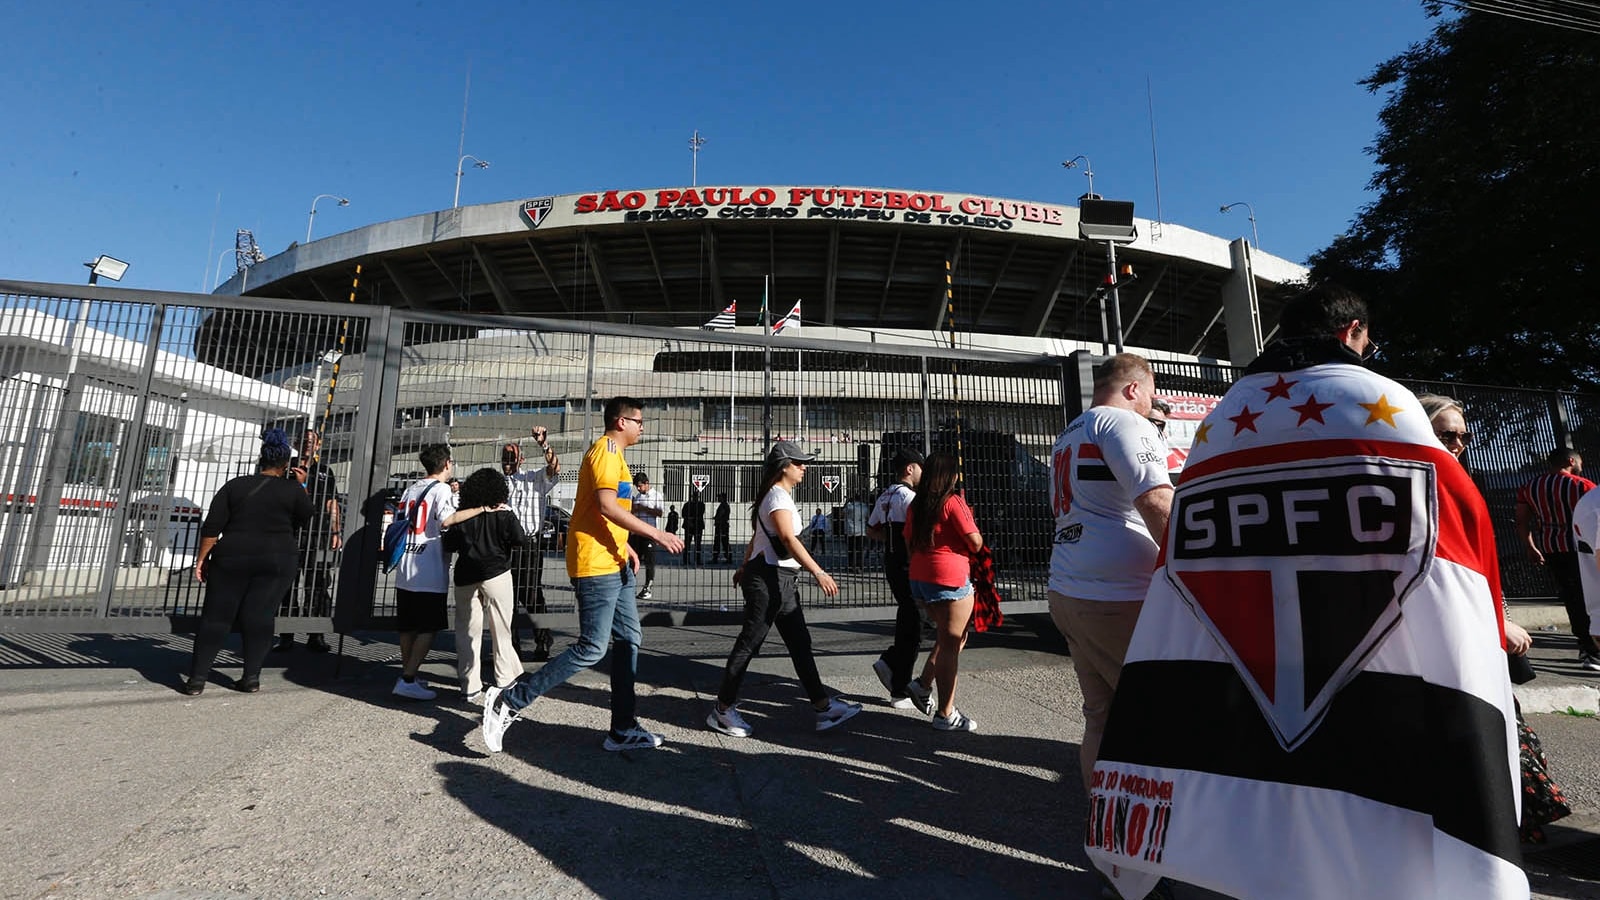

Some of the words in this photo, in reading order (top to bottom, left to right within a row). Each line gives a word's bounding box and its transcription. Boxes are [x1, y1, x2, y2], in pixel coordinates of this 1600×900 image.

[526, 199, 551, 208] SPFC
[576, 190, 646, 213] SÃO
[657, 188, 776, 208] PAULO
[788, 188, 952, 213] FUTEBOL
[959, 197, 1063, 225] CLUBE
[807, 206, 895, 221] POMPEU
[903, 212, 931, 224] DE
[937, 213, 1013, 230] TOLEDO
[1184, 484, 1396, 550] SPFC
[1105, 770, 1118, 790] DO
